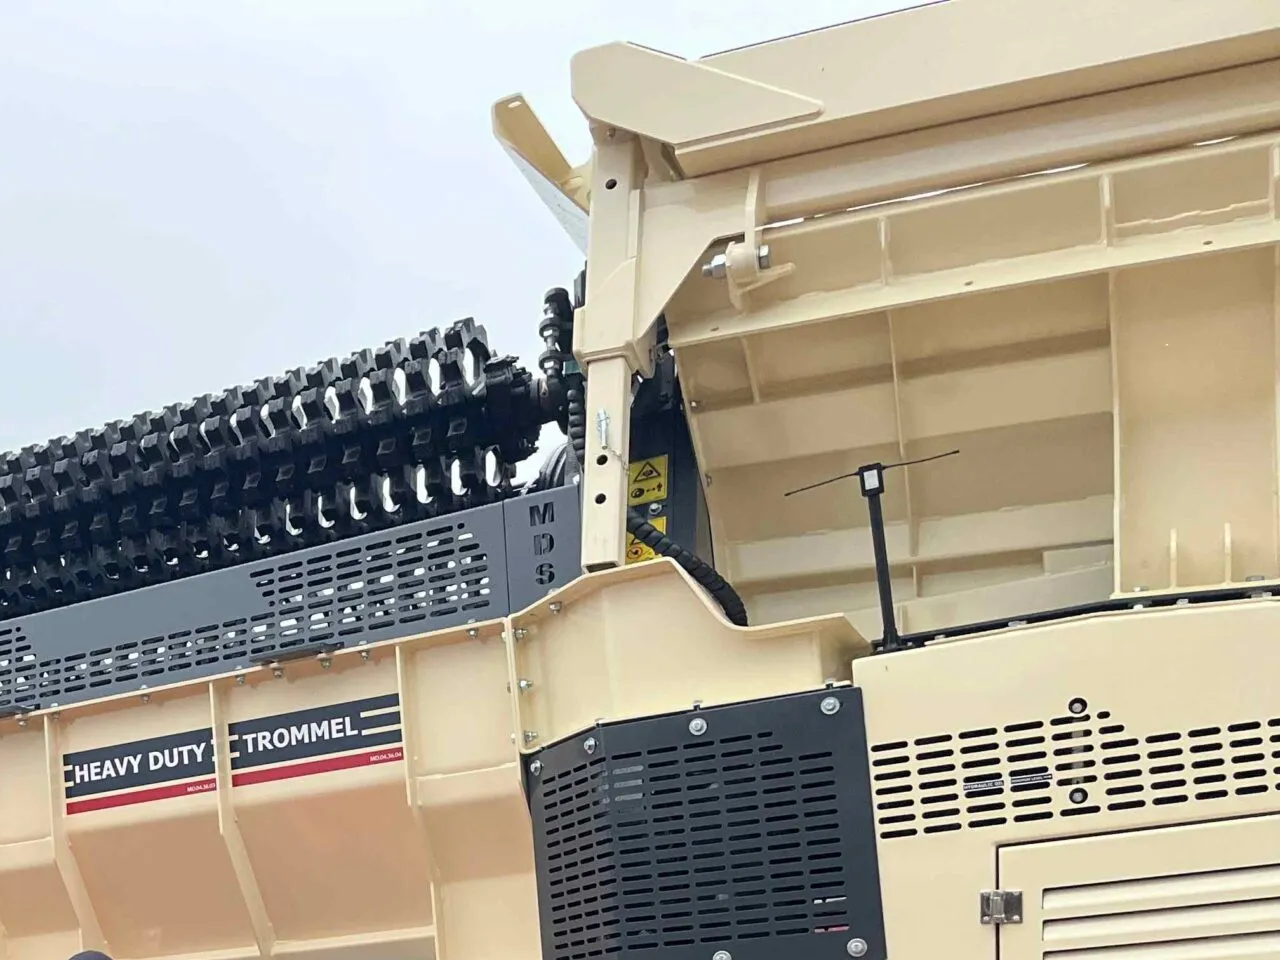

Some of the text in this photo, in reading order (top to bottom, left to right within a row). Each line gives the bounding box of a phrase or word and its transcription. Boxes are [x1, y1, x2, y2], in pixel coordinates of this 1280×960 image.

[529, 502, 556, 585] MDS
[75, 716, 359, 784] HEAVY DUTY TROMMEL
